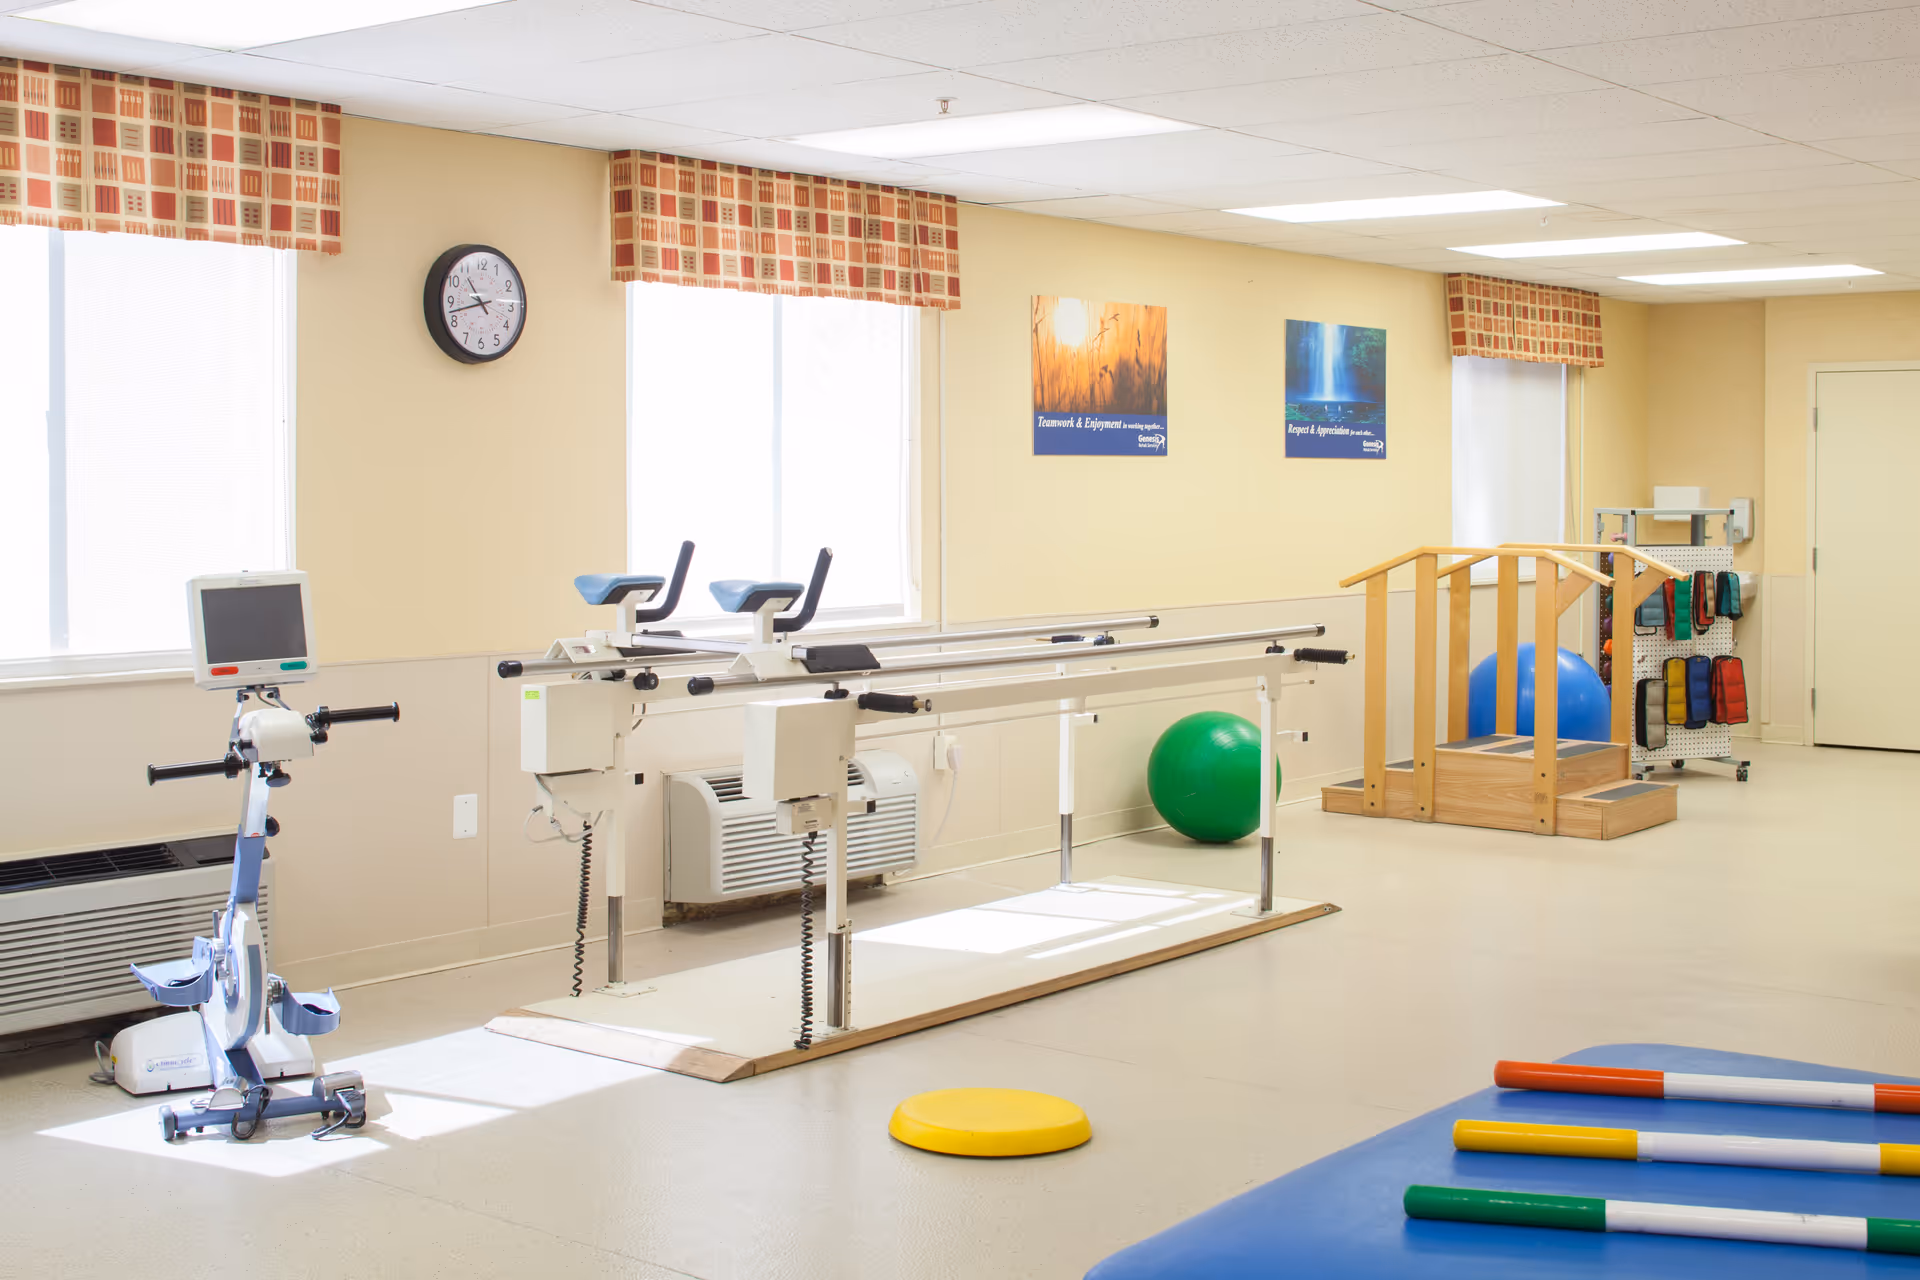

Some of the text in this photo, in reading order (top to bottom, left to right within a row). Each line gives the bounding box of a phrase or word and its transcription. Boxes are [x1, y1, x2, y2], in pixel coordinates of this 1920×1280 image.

[460, 263, 469, 273] 11
[477, 258, 487, 270] 12
[493, 263, 499, 276] 1
[449, 275, 460, 288] 10
[505, 280, 512, 292] 2
[447, 295, 454, 308] 9
[507, 302, 514, 312] 3
[450, 315, 458, 327] 8
[503, 319, 509, 331] 4
[462, 332, 469, 344] 7
[478, 337, 485, 350] 6
[493, 334, 500, 346] 5
[1037, 415, 1075, 428] Teamwork
[1076, 416, 1083, 428] &
[1084, 417, 1122, 431] Enjoyment
[1288, 423, 1309, 436] Respect
[1309, 424, 1315, 434] &
[1316, 424, 1349, 437] Appreciation
[1138, 434, 1160, 443] Genesis
